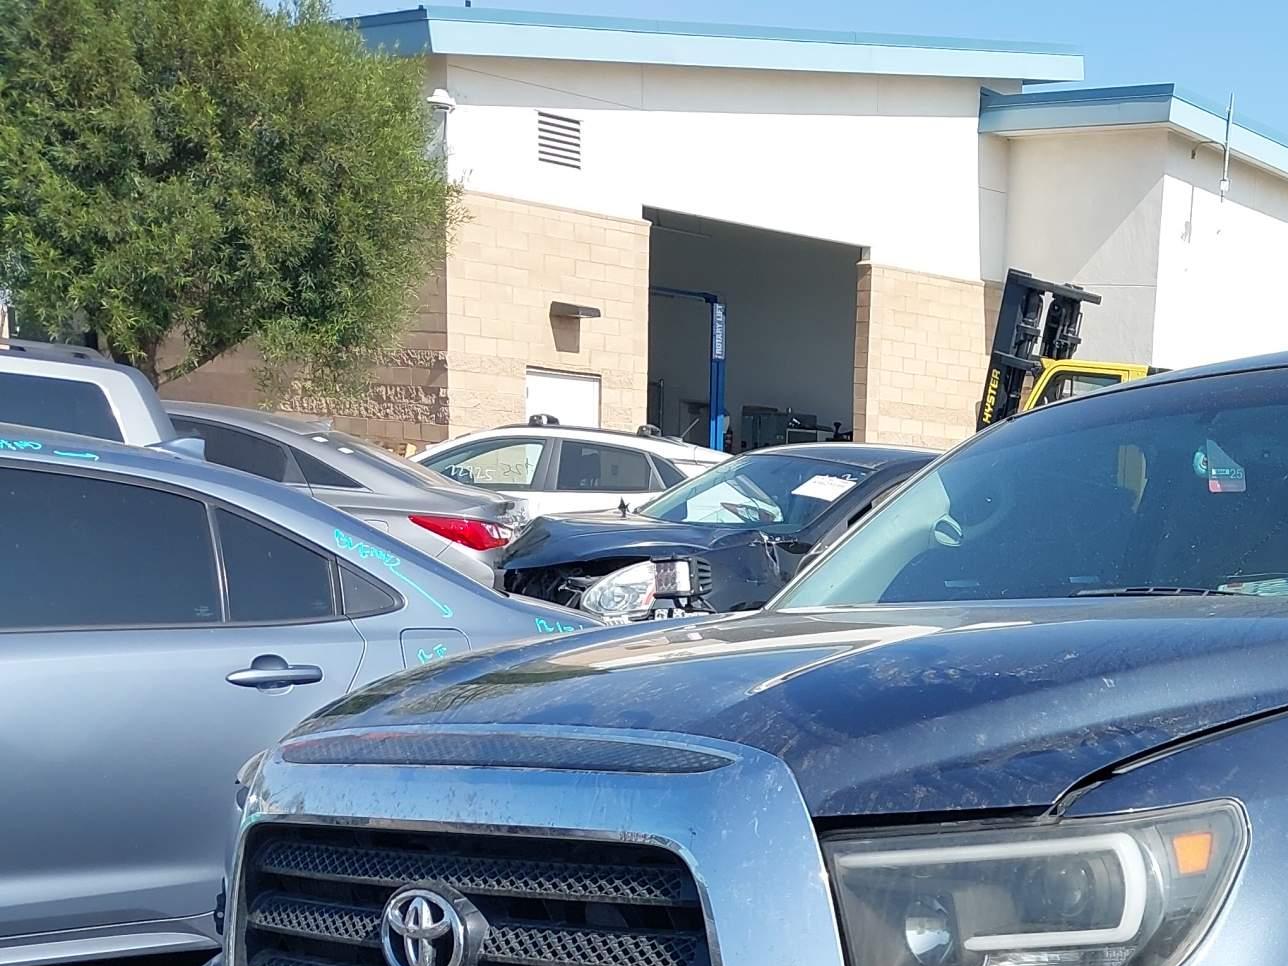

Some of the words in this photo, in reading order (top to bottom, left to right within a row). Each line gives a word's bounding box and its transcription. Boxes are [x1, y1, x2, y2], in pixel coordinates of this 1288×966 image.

[715, 303, 723, 321] LIFT
[715, 322, 723, 355] ROTARY
[982, 368, 1001, 424] HYSTER
